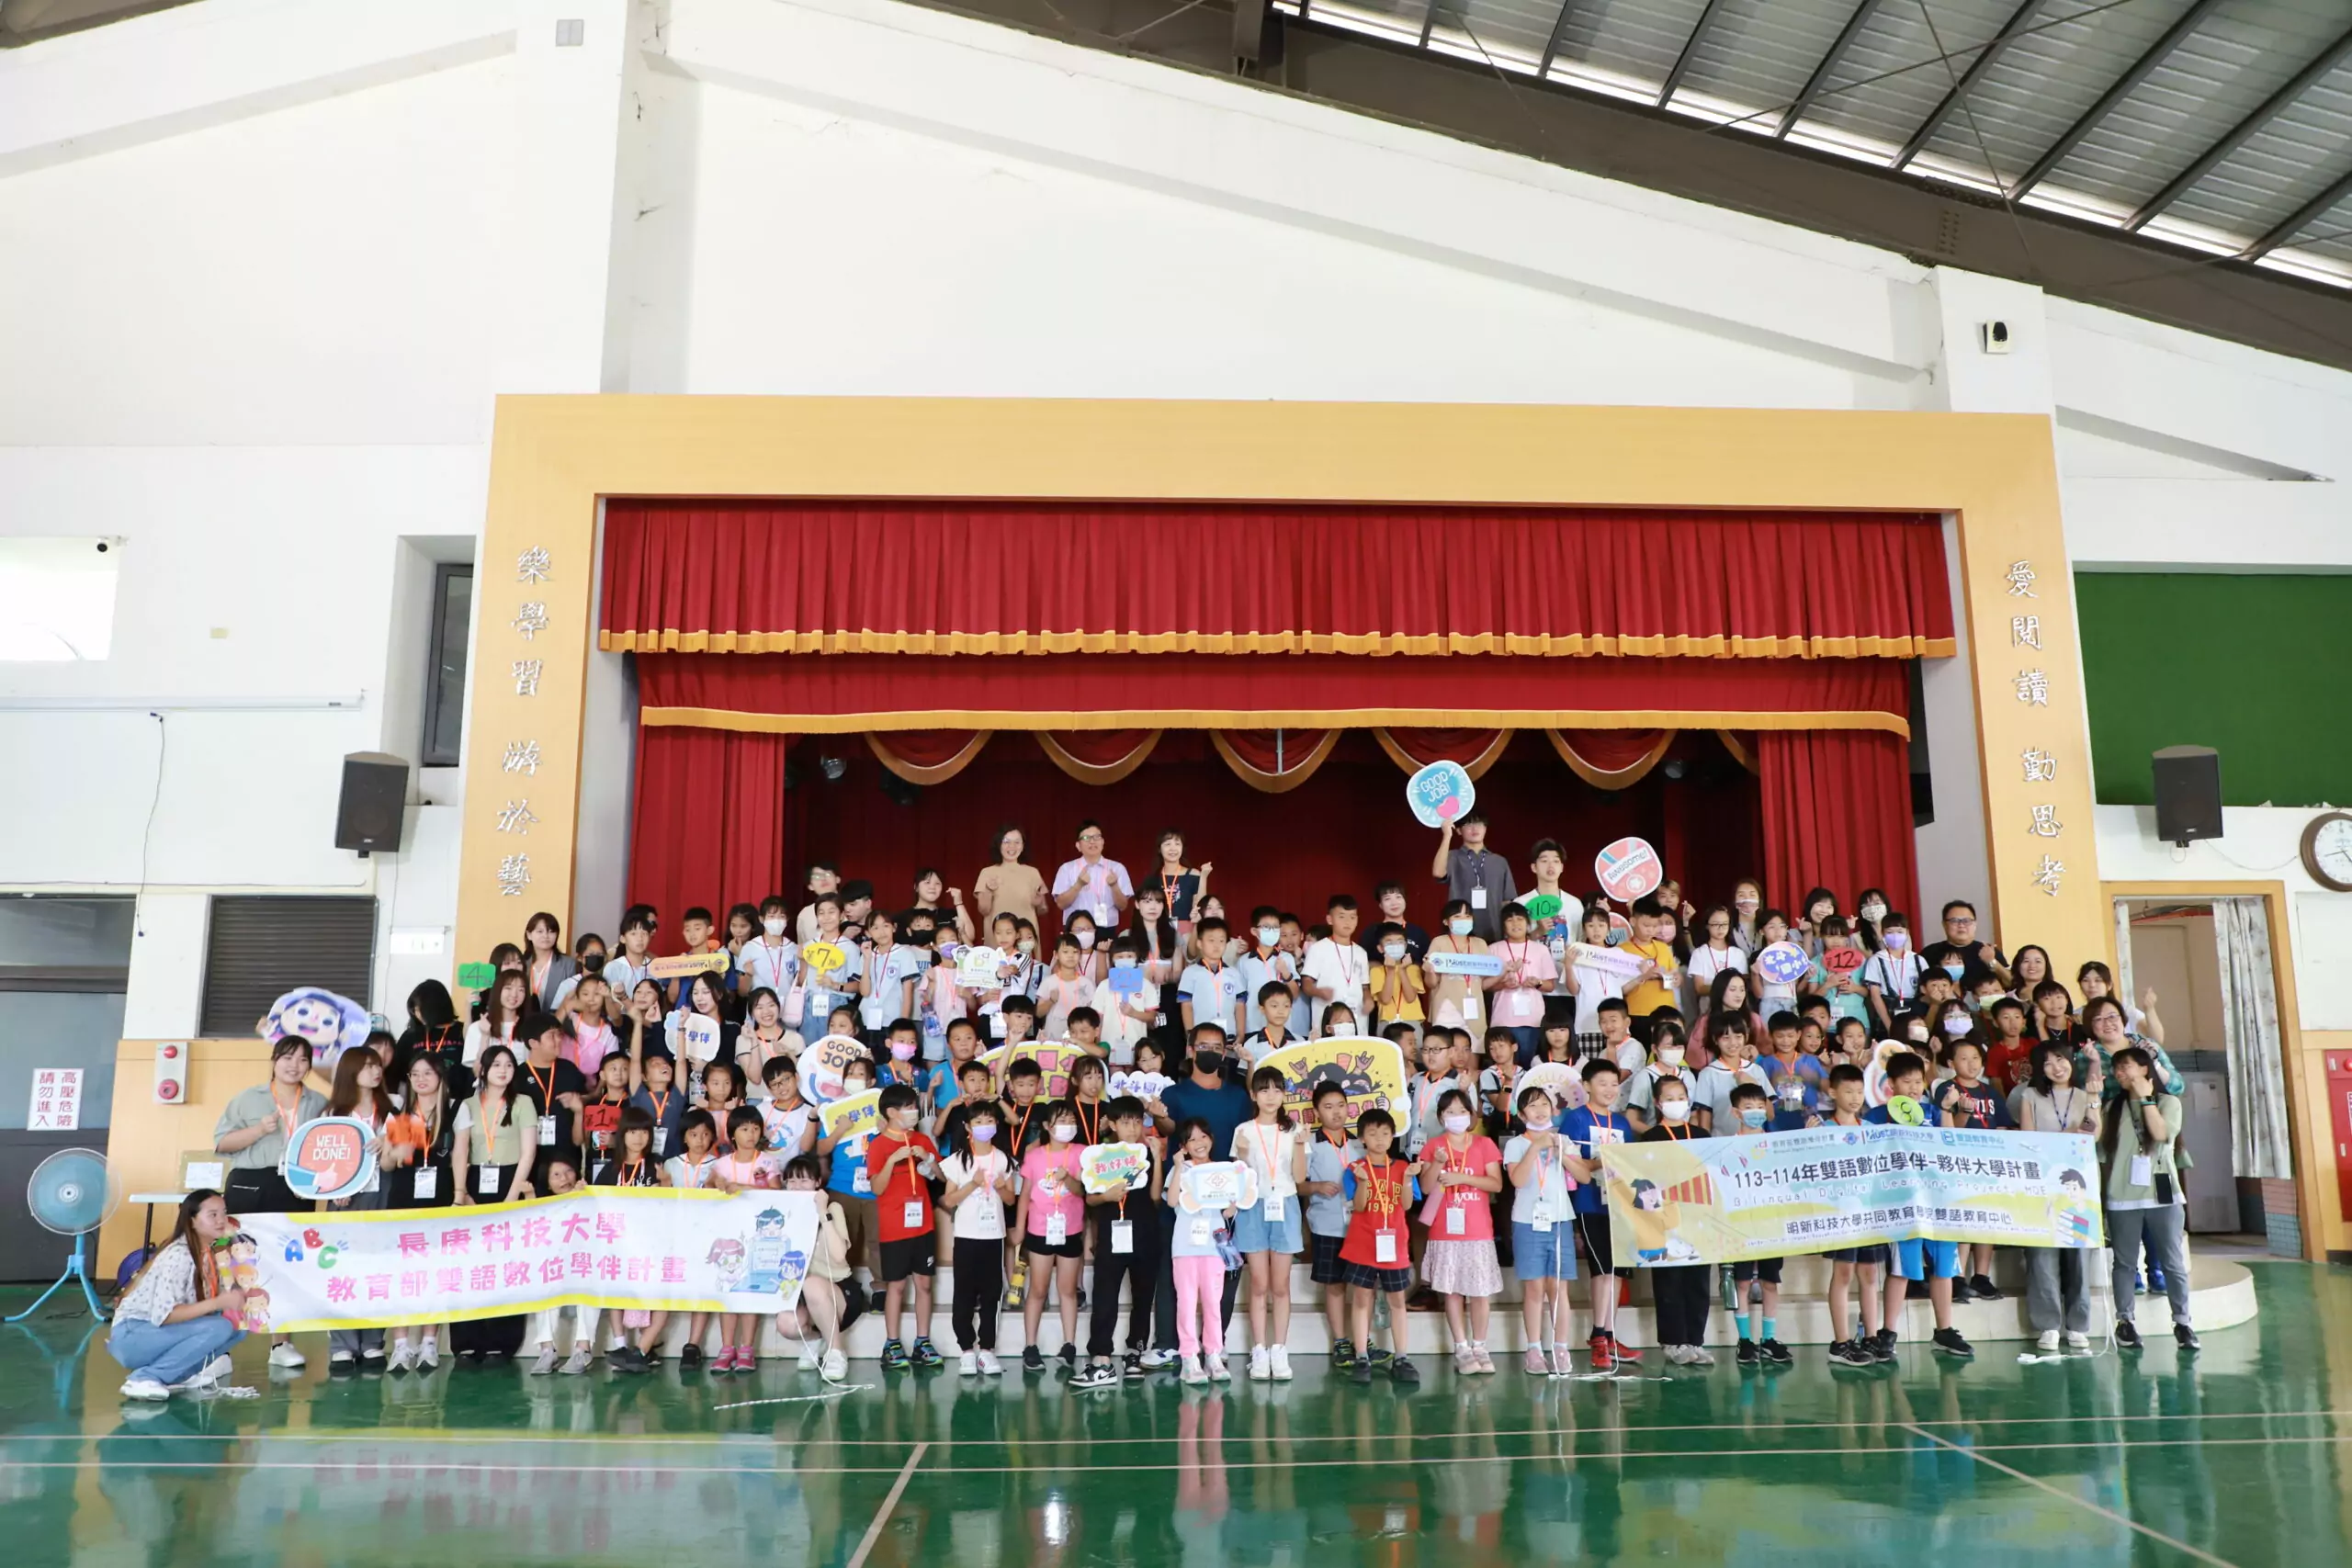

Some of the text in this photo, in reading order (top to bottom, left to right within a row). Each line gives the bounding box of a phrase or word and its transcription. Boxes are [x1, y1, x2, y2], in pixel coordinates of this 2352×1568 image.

[496, 546, 555, 896] 樂學習 游於藝
[2005, 559, 2067, 897] 愛閱讀 勤思考
[1419, 772, 1449, 793] GOOD
[1607, 849, 1647, 880] Awesome!
[827, 1041, 862, 1057] GOOD
[35, 1071, 55, 1127] 請勿進入
[56, 1071, 77, 1127] 高壓危險
[312, 1147, 351, 1160] DONE!
[316, 1134, 348, 1147] WELL
[1368, 1202, 1395, 1213] 199
[1734, 1190, 1807, 1207] Bilingual
[284, 1228, 339, 1269] ABC
[397, 1212, 628, 1260] 長庚科技大學
[326, 1251, 688, 1303] 教育部雙語數位學伴計畫
